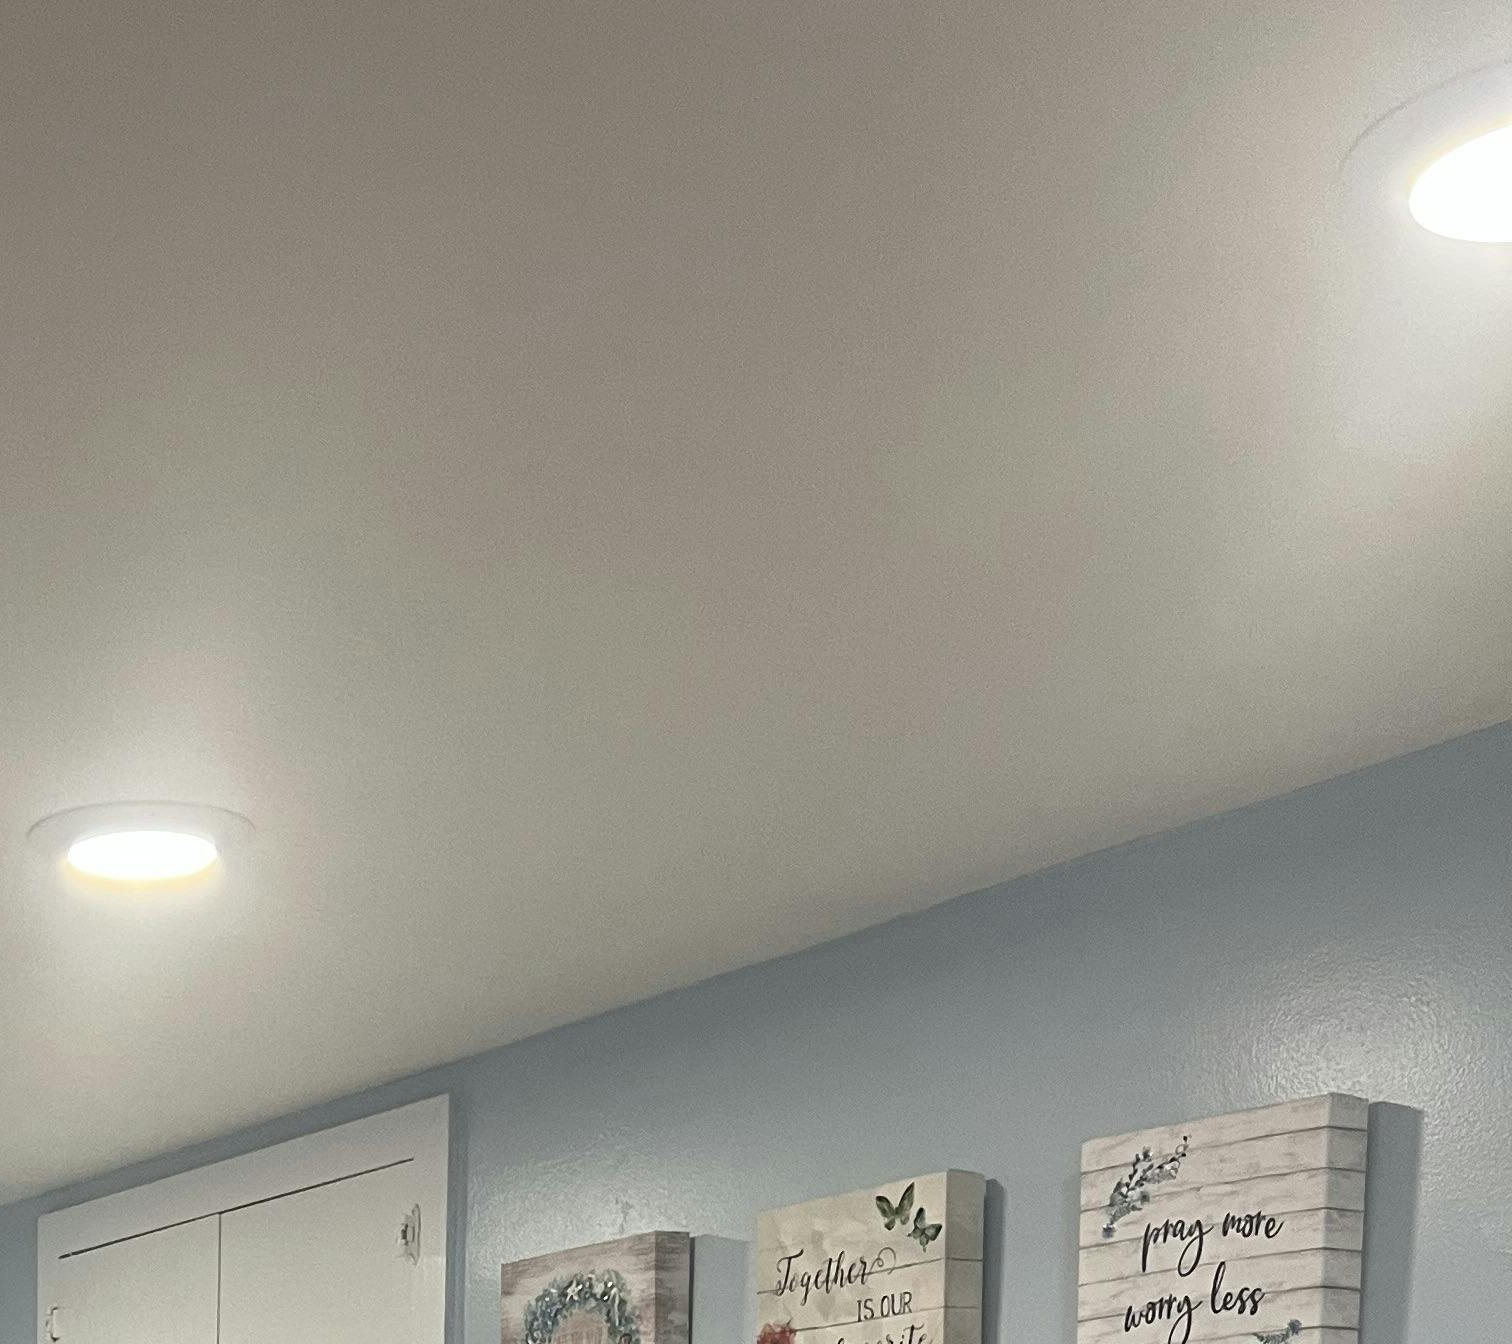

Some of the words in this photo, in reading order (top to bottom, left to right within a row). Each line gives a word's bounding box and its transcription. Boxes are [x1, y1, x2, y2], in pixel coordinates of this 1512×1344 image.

[1141, 1219, 1215, 1277] pray
[1222, 1210, 1284, 1239] more
[775, 1247, 896, 1306] Together
[1210, 1261, 1265, 1315] less
[857, 1299, 875, 1322] IS
[880, 1291, 913, 1317] OUR
